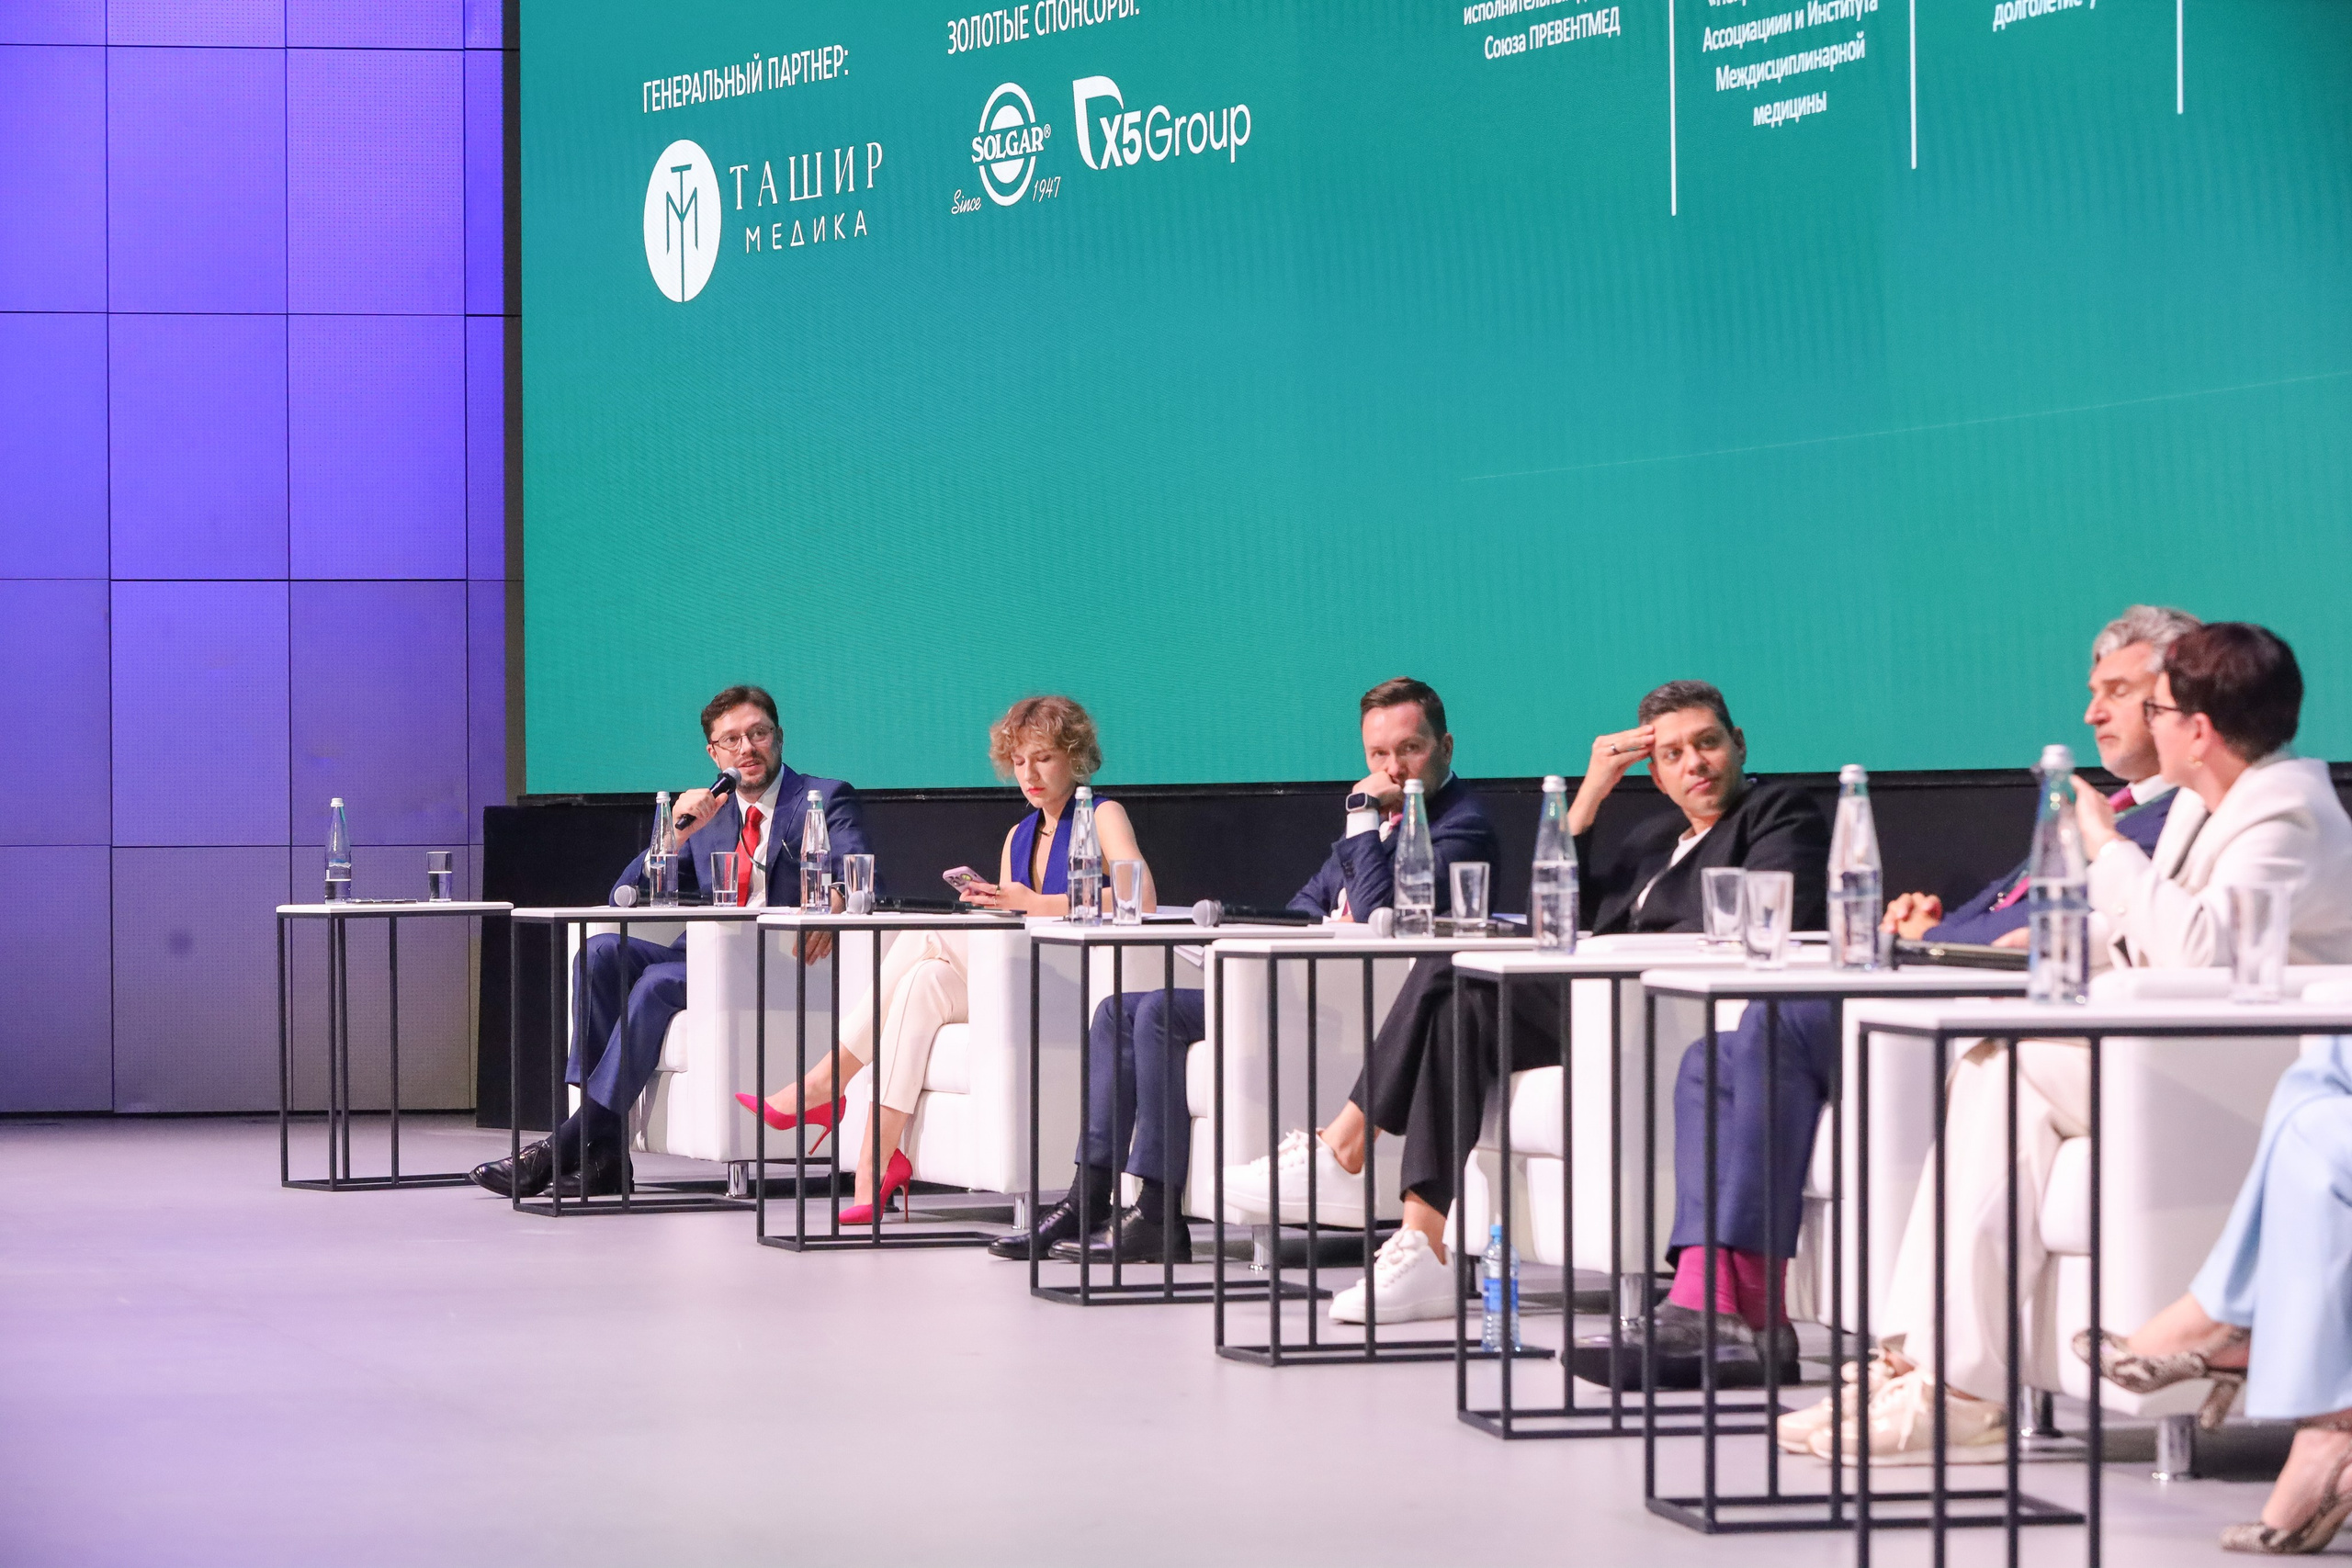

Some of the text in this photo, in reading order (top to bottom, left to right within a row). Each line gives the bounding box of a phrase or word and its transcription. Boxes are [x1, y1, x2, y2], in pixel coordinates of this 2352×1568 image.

[946, 4, 1030, 55] ЗОЛОТЫЕ
[1484, 6, 1621, 60] Союза ПРЕВЕНТМЕД
[1794, 8, 1804, 30] и
[643, 44, 849, 113] ГЕНЕРАЛЬНЫЙ ПАРТНЕР:
[1715, 30, 1866, 92] Междисциплинарной
[1753, 90, 1827, 129] медицины
[729, 141, 883, 210] ТАШИР
[951, 175, 1061, 215] Since 1947
[745, 209, 867, 254] МЕДИКА
